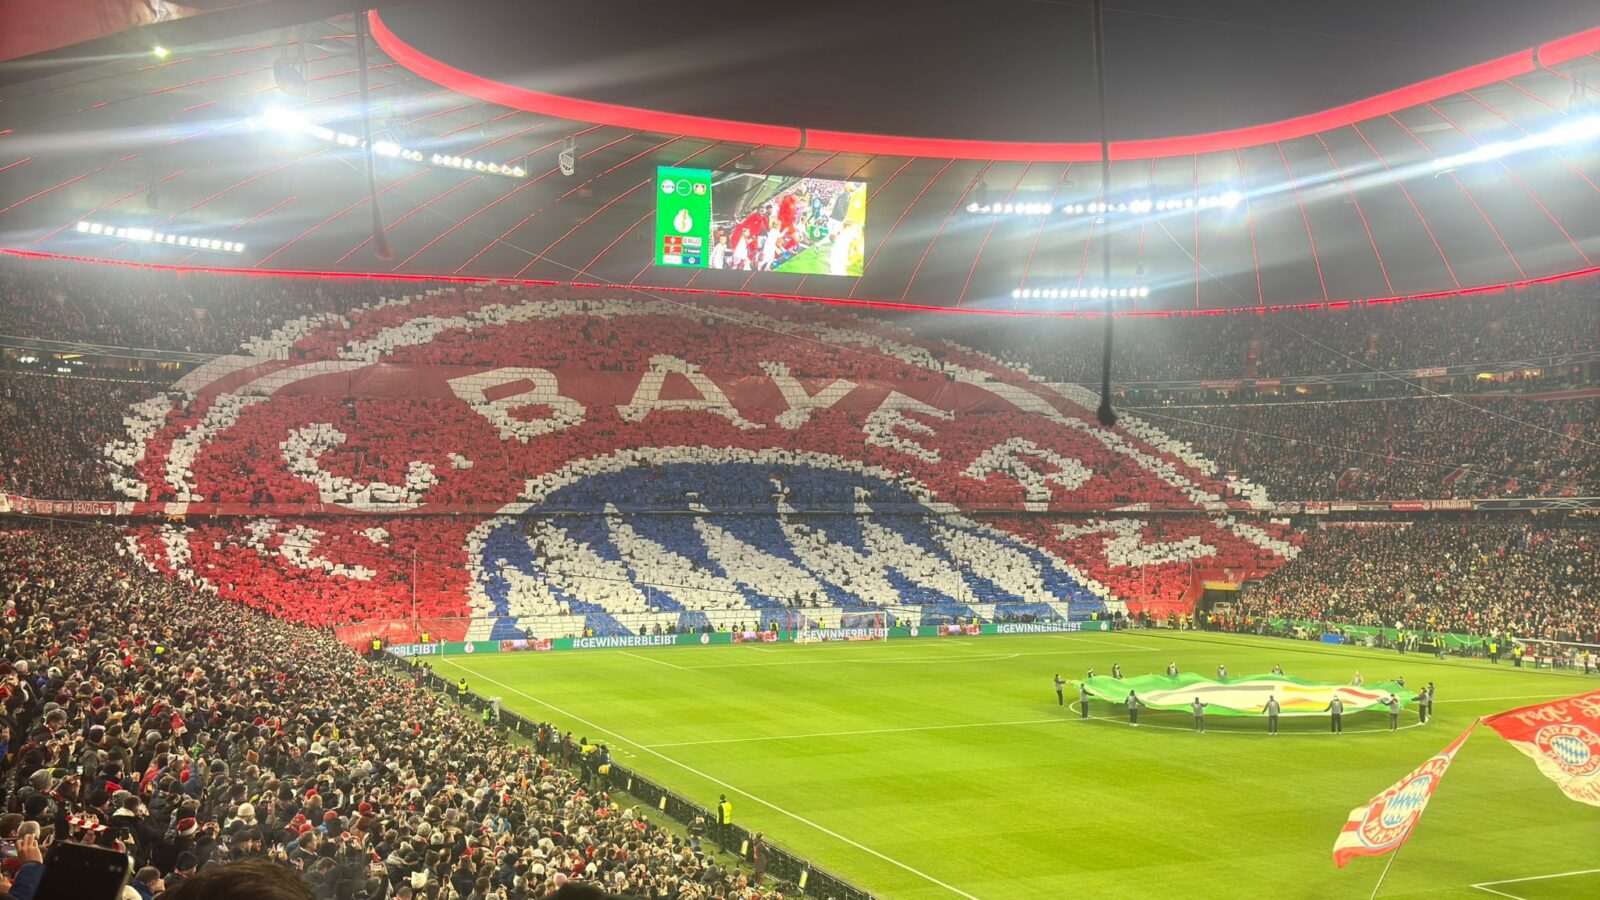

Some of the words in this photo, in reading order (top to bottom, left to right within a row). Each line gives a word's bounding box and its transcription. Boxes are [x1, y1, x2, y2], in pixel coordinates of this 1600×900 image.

[684, 238, 701, 246] ERGO
[449, 354, 1217, 568] BAYERN
[796, 628, 890, 640] #GEWINNERBLEIBT
[996, 622, 1082, 634] #GEWINNERBLEIBT
[572, 635, 678, 648] #GEWINNERBLEIBT
